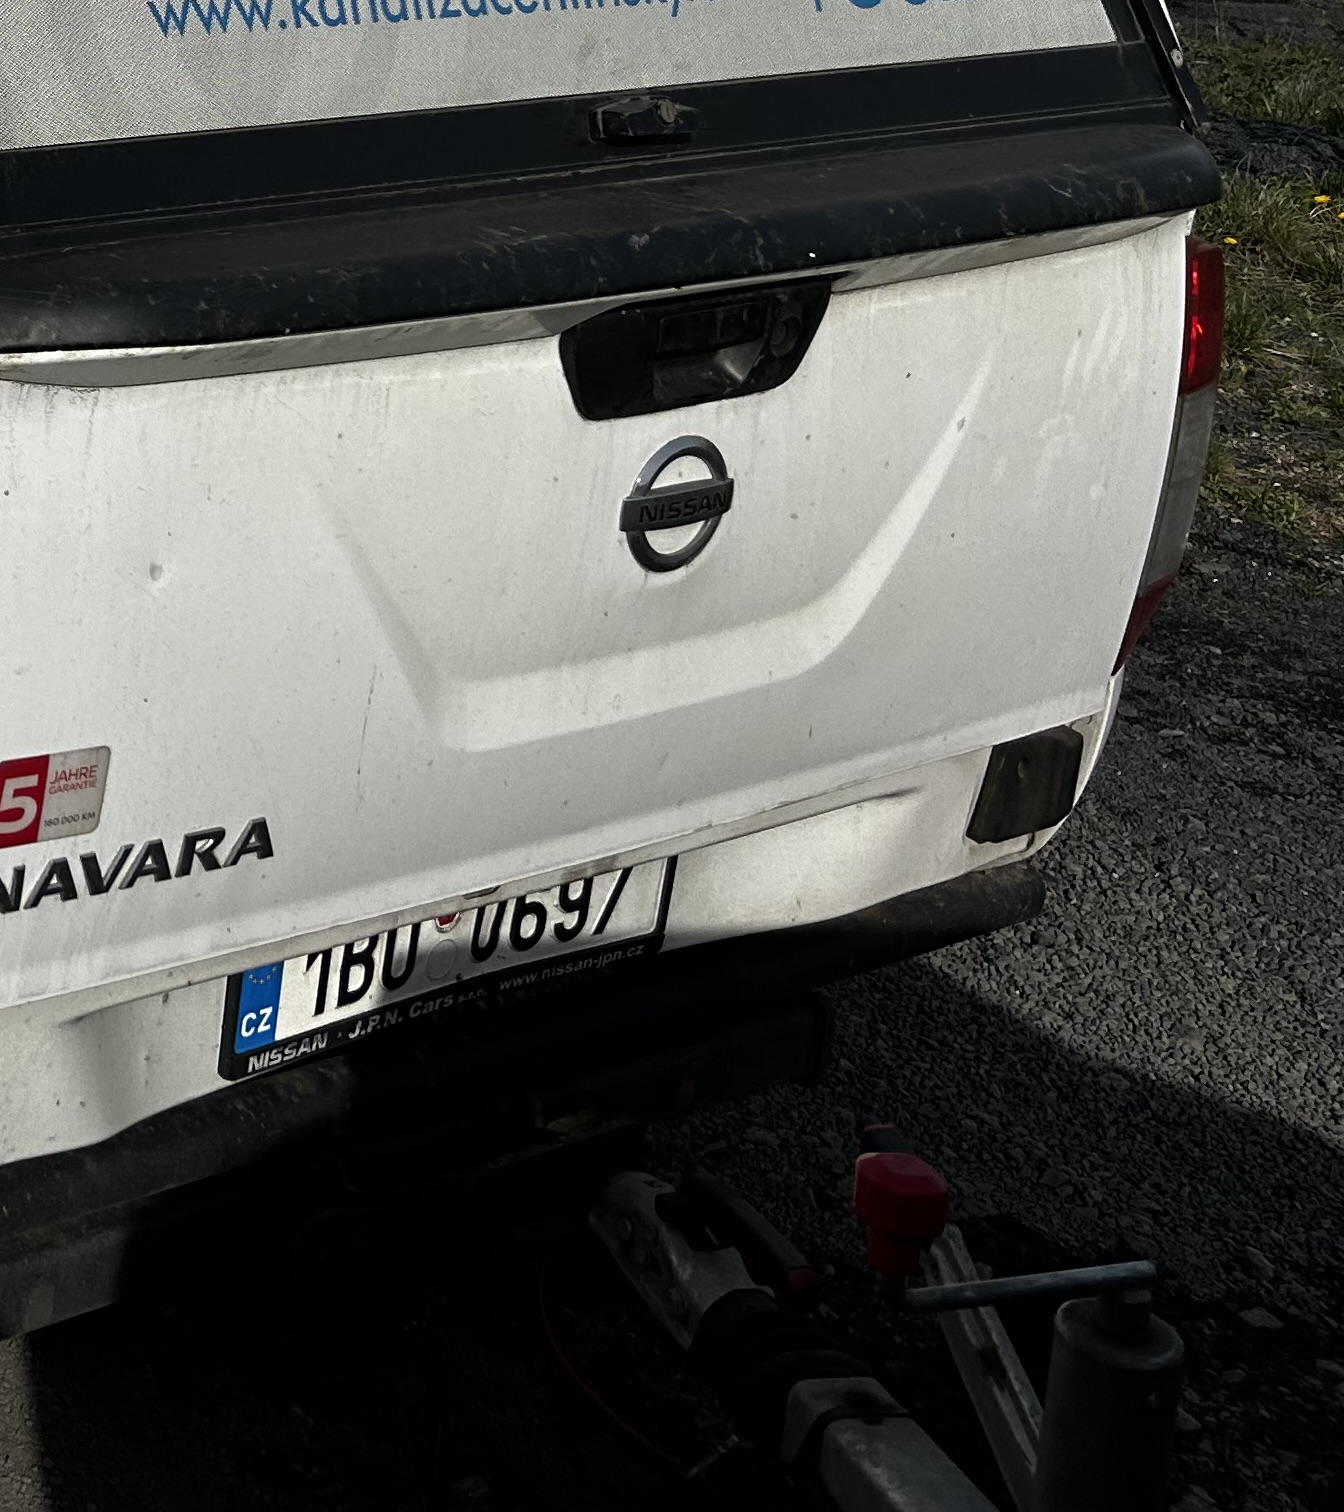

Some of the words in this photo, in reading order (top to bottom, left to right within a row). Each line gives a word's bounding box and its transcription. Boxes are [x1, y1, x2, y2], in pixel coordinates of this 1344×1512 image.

[638, 490, 727, 524] NISSAN
[48, 778, 98, 795] GARANTIE
[49, 765, 98, 785] JAHRE
[61, 815, 81, 826] 000
[82, 811, 96, 821] KM
[240, 1006, 273, 1038] CZ
[247, 1032, 329, 1074] NISSAN
[348, 1008, 404, 1039] J.P.N.
[409, 993, 454, 1019] Cars
[499, 944, 645, 992] www.nissan-jpn.cz
